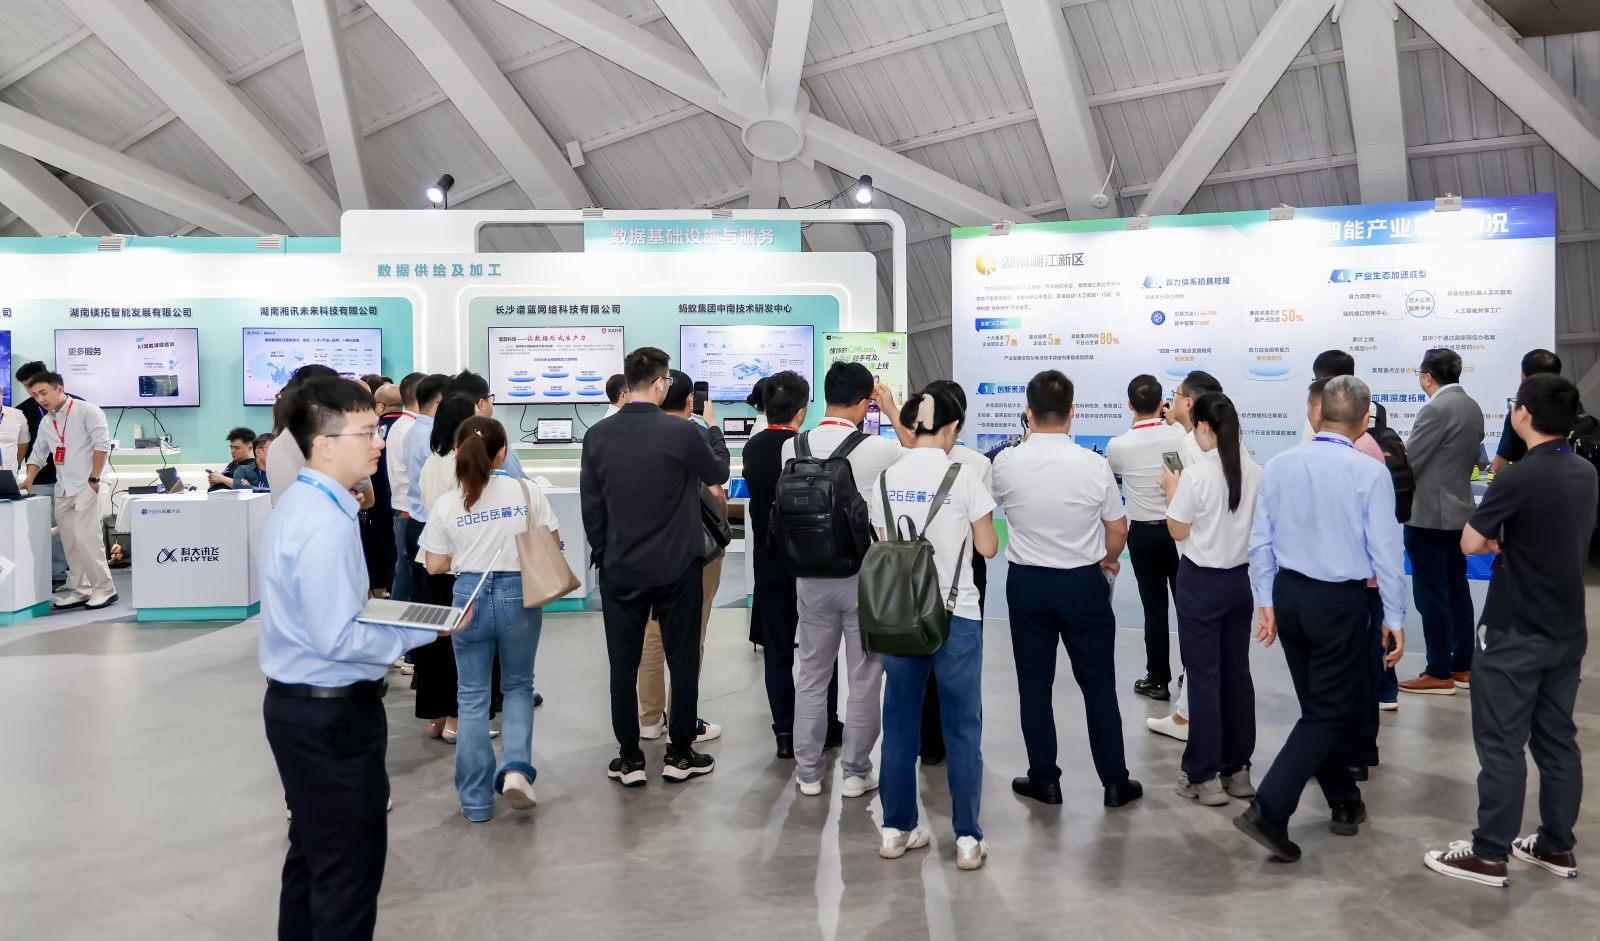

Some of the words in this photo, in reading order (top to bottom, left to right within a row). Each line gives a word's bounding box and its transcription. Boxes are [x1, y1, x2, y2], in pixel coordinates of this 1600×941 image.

[610, 228, 776, 246] 数据基础设施与服务
[1002, 252, 1085, 269] 湖南湘江新区
[377, 263, 503, 278] 数据供给及加工
[1354, 270, 1427, 281] 产业生态加速成型
[1165, 277, 1231, 287] 算力体系初具规模
[1447, 289, 1513, 297] 具身智能机器人实训基地
[69, 307, 192, 318] 湖南镁拓智能发展有限公司
[260, 306, 378, 317] 湖南湘讯未来科技有限公司
[495, 305, 621, 315] 长沙谱蓝网络科技有限公司
[678, 304, 793, 315] 蚂蚁集团中南技术研发中心
[1454, 307, 1502, 315] 人工智能共享工厂
[1281, 309, 1304, 323] 50%
[1100, 332, 1120, 345] 80%
[68, 347, 101, 356] 更多服务
[1371, 393, 1426, 403] 应用深度拓展
[181, 547, 219, 556] 科大讯飞
